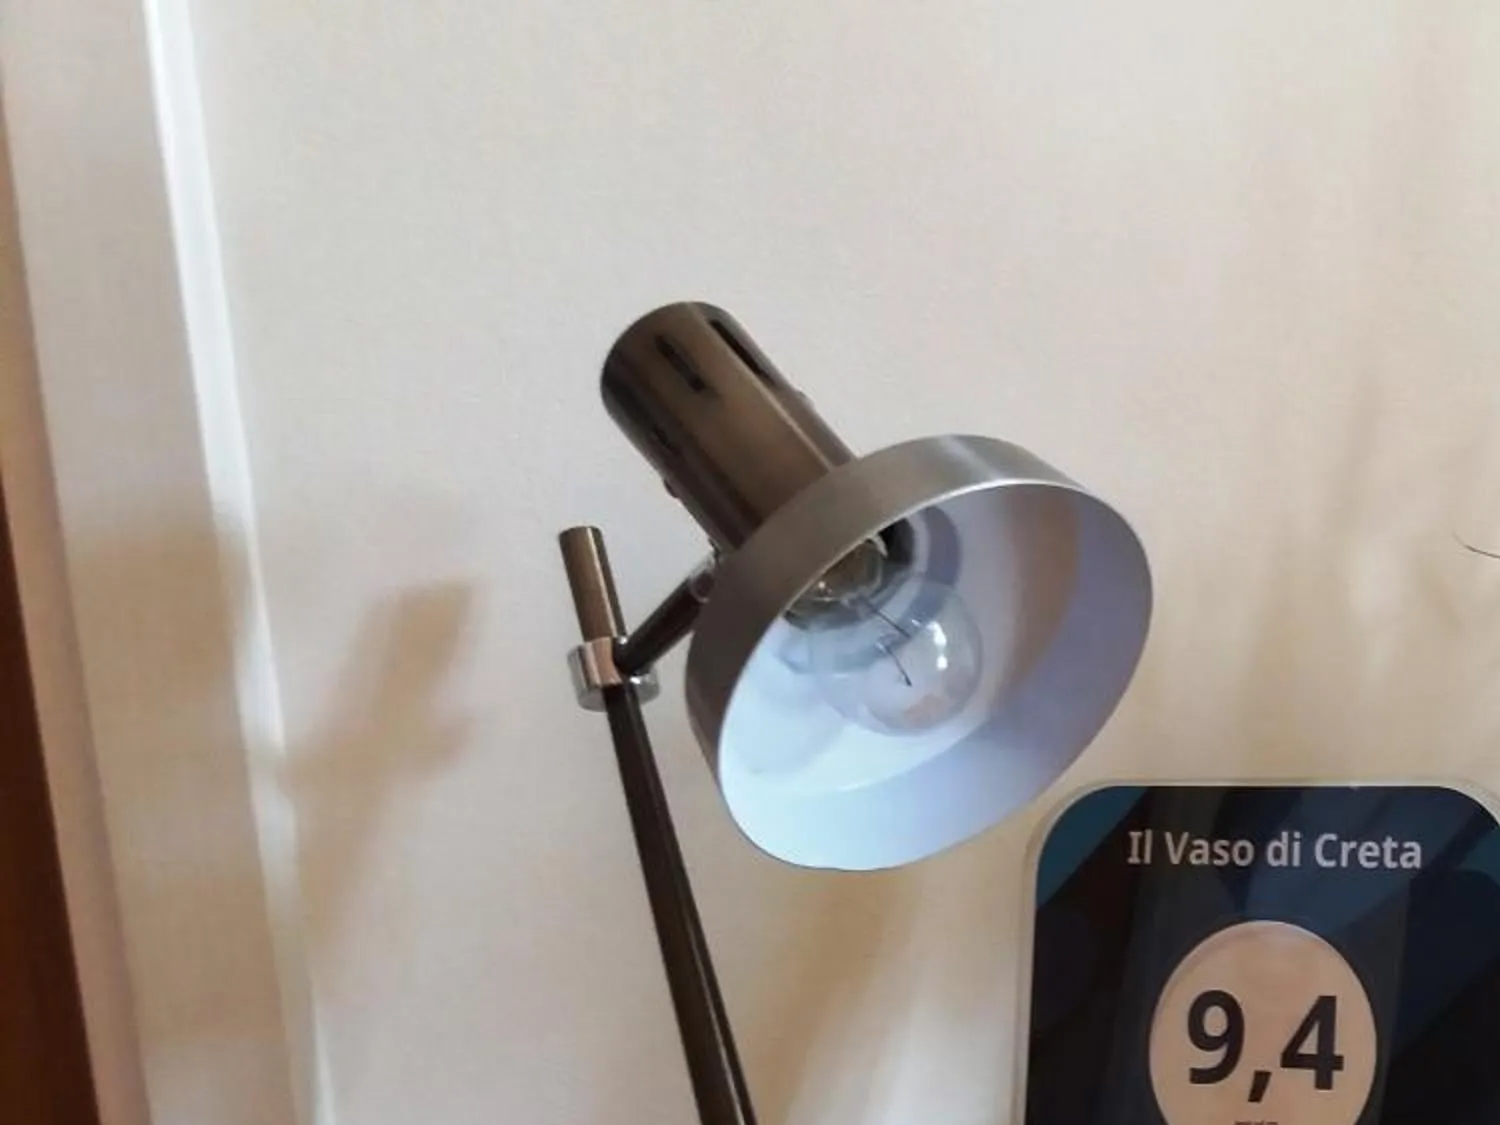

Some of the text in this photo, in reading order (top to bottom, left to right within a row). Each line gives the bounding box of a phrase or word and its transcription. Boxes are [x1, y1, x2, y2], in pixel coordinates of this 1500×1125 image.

[1127, 830, 1422, 870] Il Vaso di Creta
[1187, 989, 1345, 1104] 9,4
